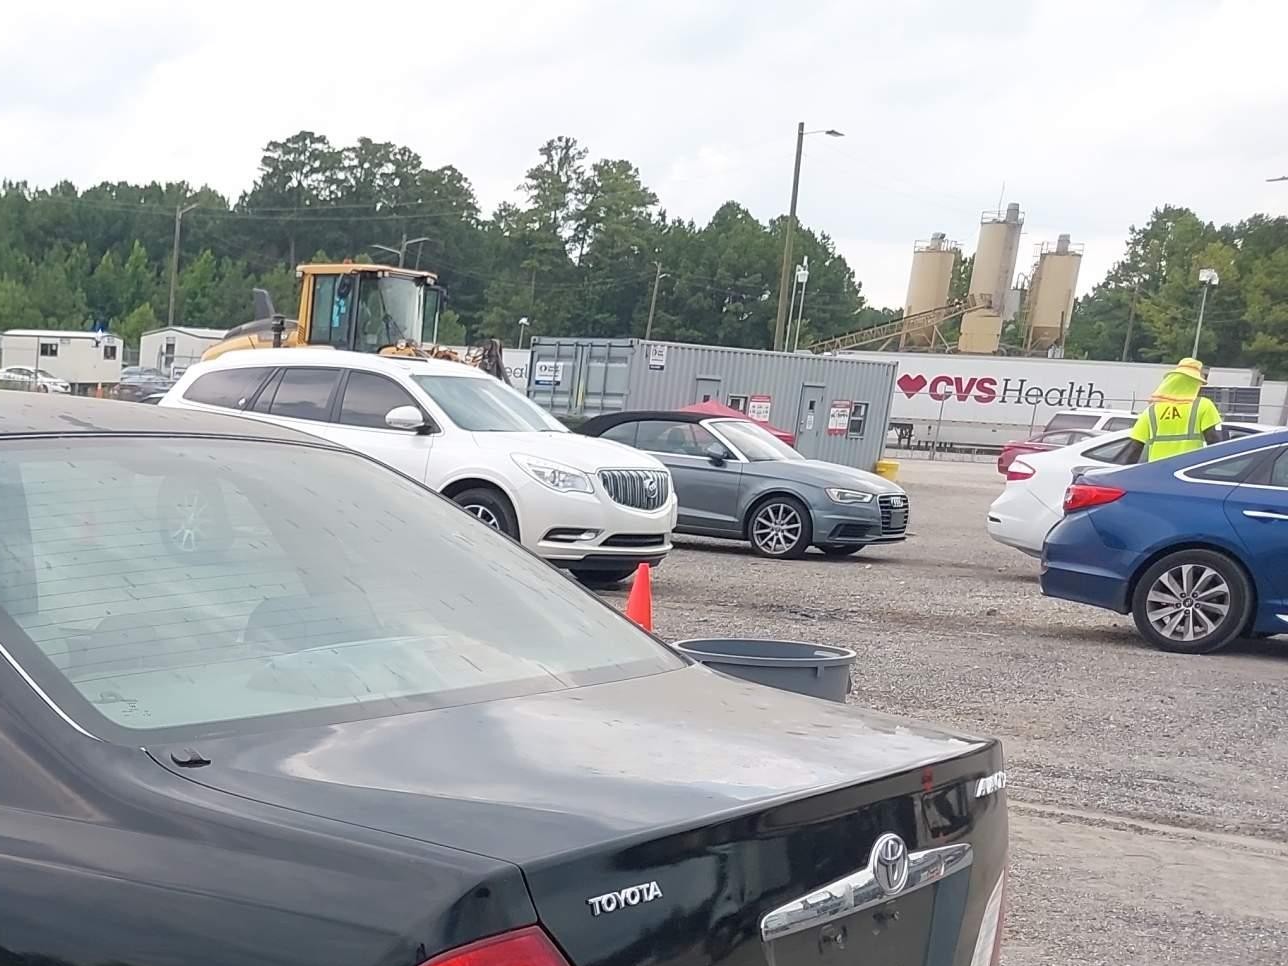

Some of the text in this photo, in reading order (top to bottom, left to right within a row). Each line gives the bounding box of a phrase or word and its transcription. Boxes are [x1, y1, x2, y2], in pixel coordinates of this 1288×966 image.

[928, 375, 1106, 409] CVS Health
[587, 880, 664, 917] TOYOTA
